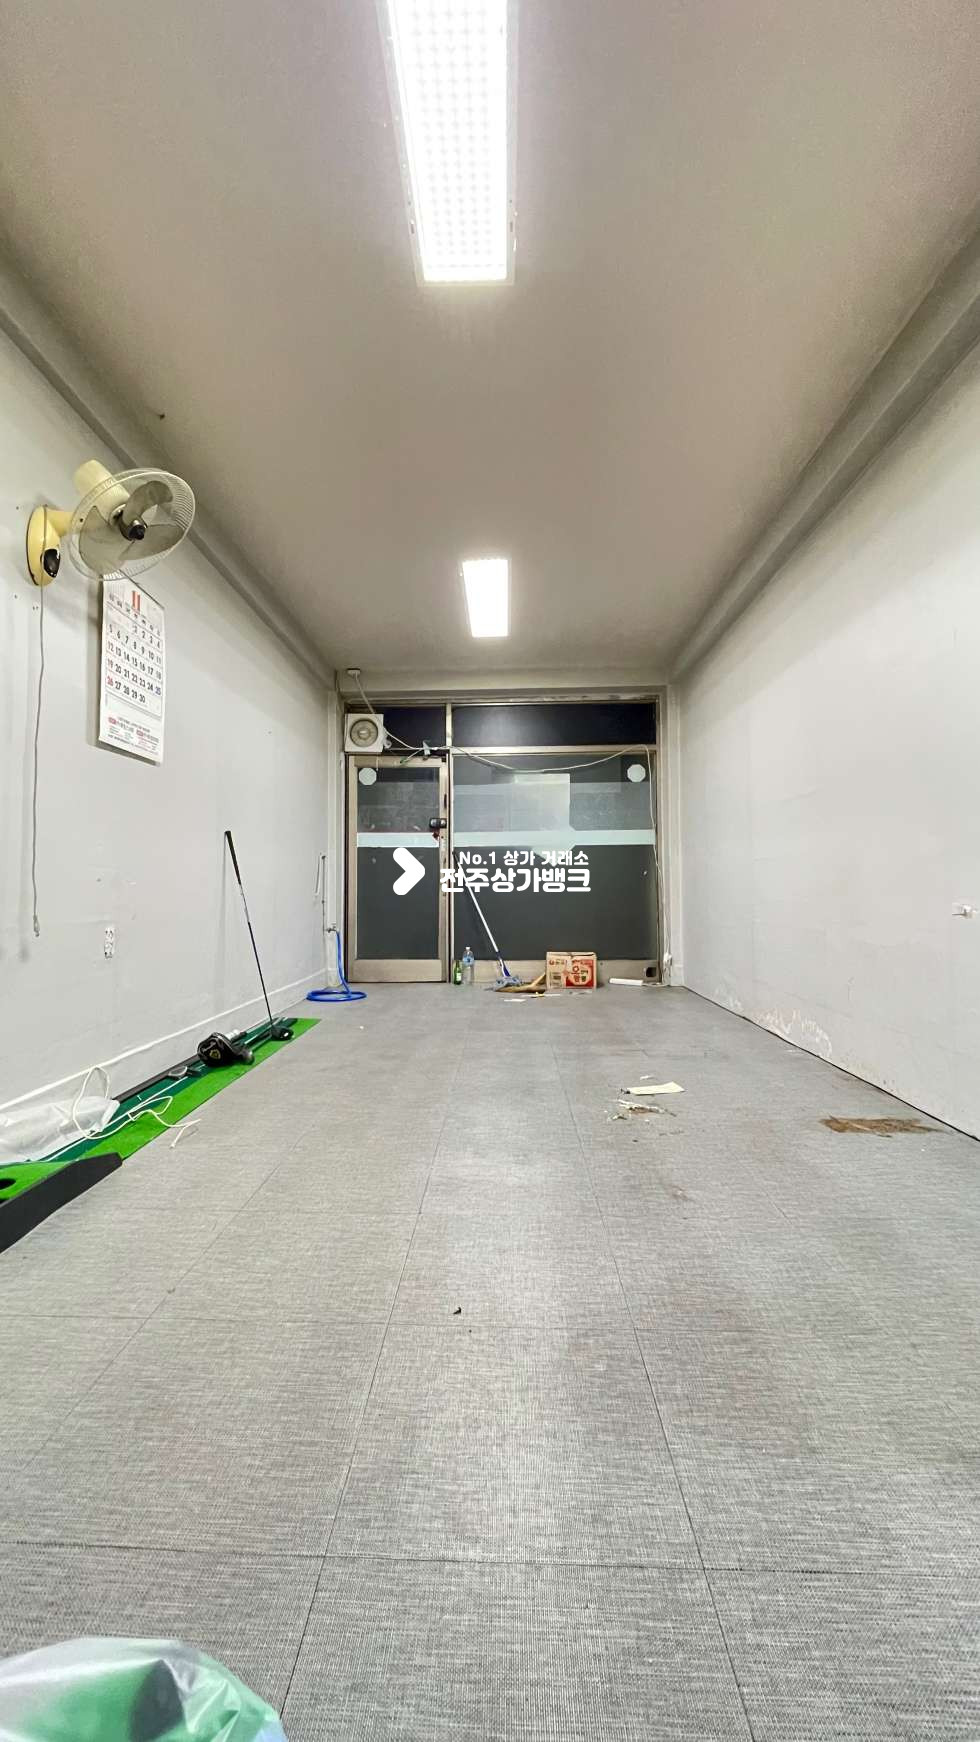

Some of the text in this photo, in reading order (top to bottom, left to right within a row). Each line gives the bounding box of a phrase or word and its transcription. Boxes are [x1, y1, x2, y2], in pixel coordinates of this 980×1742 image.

[131, 590, 141, 612] 11
[107, 675, 146, 704] 26 27 28 29 30
[115, 663, 122, 674] 20
[123, 668, 130, 679] 21
[131, 673, 138, 683] 22
[139, 677, 146, 687] 23
[147, 682, 154, 691] 24
